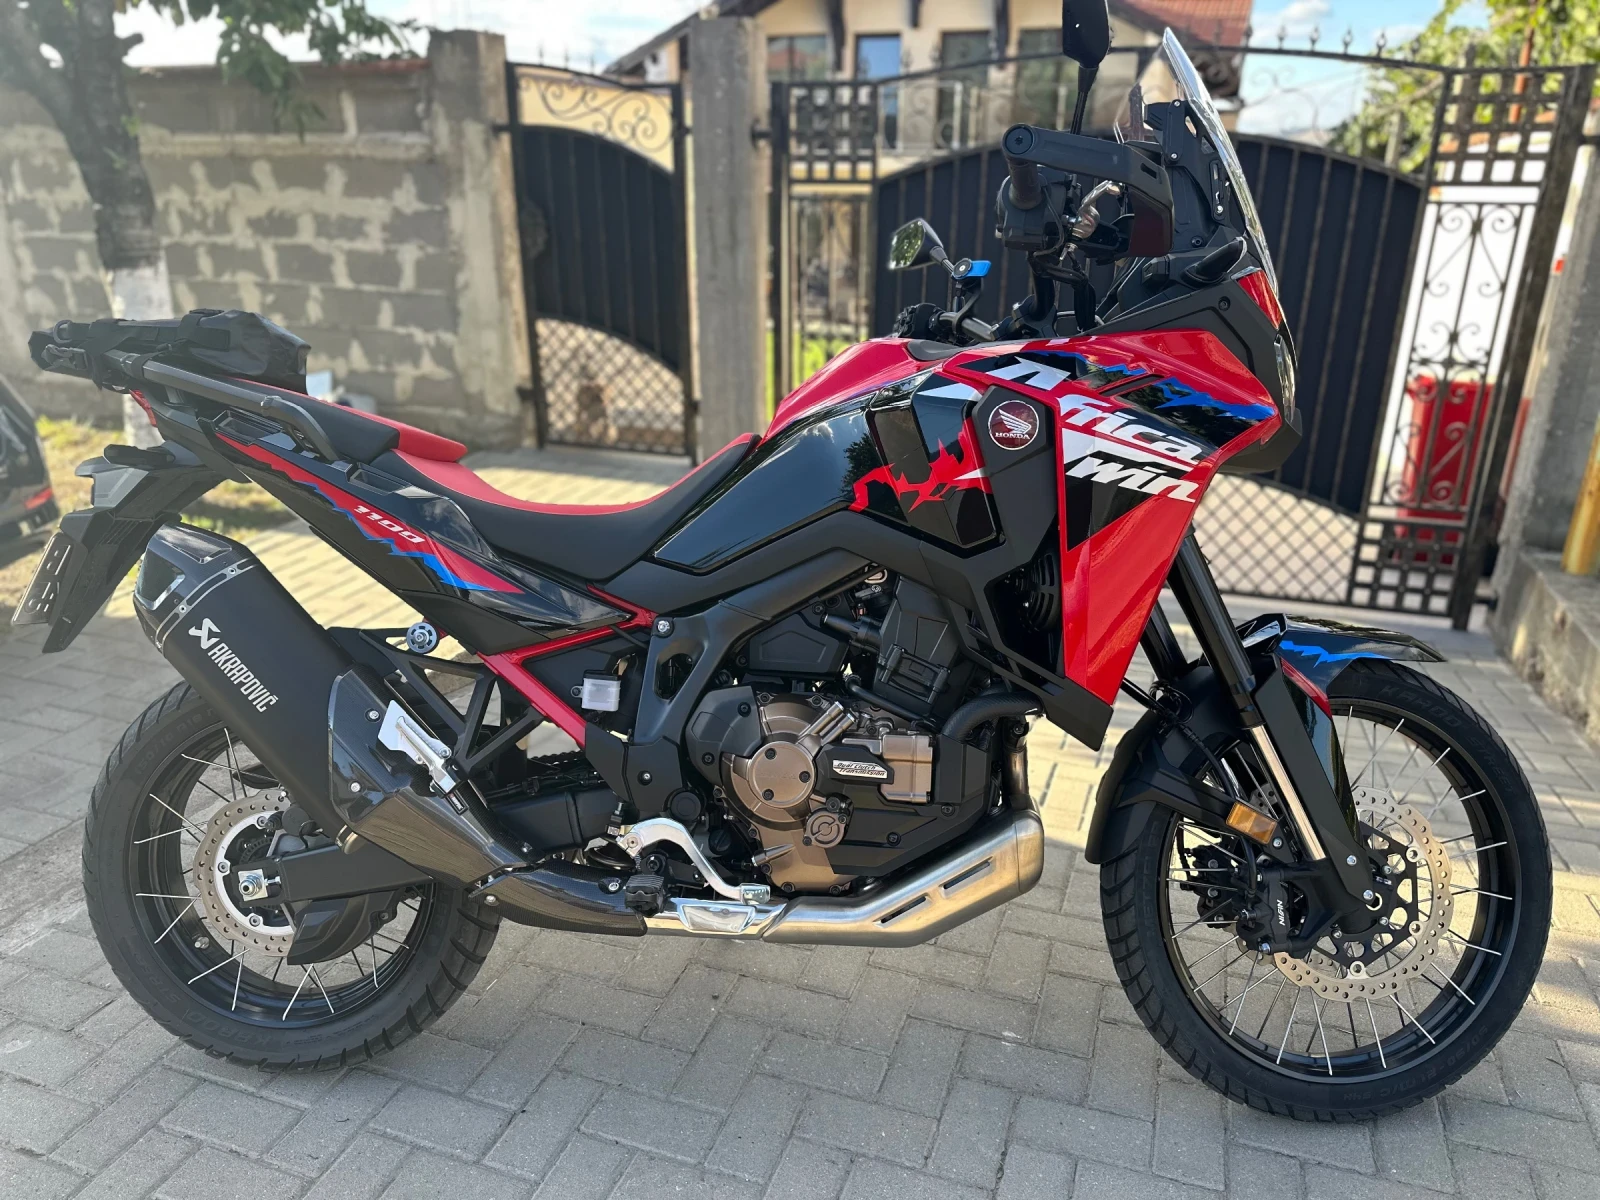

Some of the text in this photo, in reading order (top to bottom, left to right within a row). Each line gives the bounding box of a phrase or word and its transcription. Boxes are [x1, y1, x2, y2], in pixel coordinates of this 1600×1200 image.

[994, 432, 1031, 440] HONDA
[354, 505, 425, 543] 1100
[207, 642, 279, 712] AKRAPOVIČ
[1378, 685, 1463, 728] KAROO
[840, 768, 885, 776] Transmission
